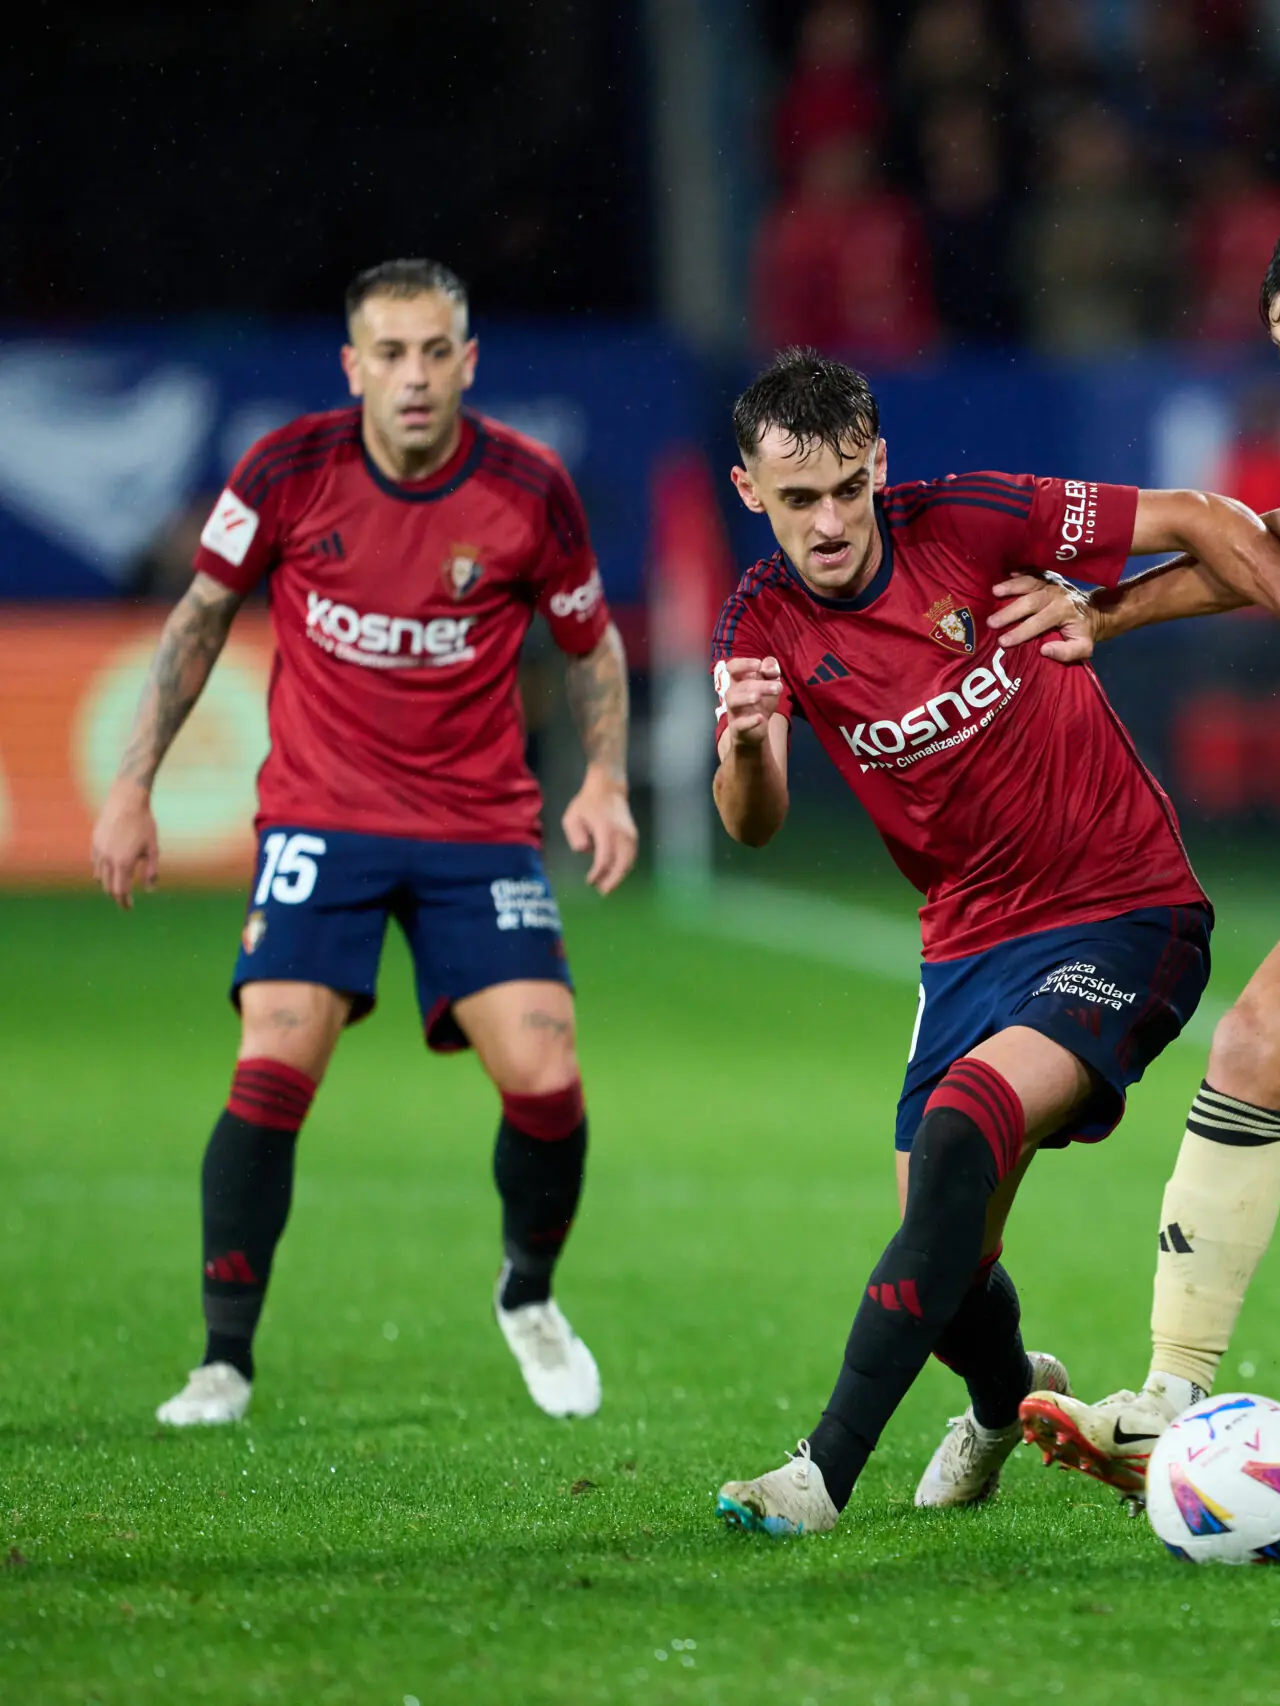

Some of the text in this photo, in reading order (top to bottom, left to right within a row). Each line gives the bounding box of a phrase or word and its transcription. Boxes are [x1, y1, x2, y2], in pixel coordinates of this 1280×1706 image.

[1061, 480, 1086, 543] CELER
[896, 723, 979, 768] Climatización
[254, 832, 327, 906] 15
[1053, 981, 1122, 1011] Navarra
